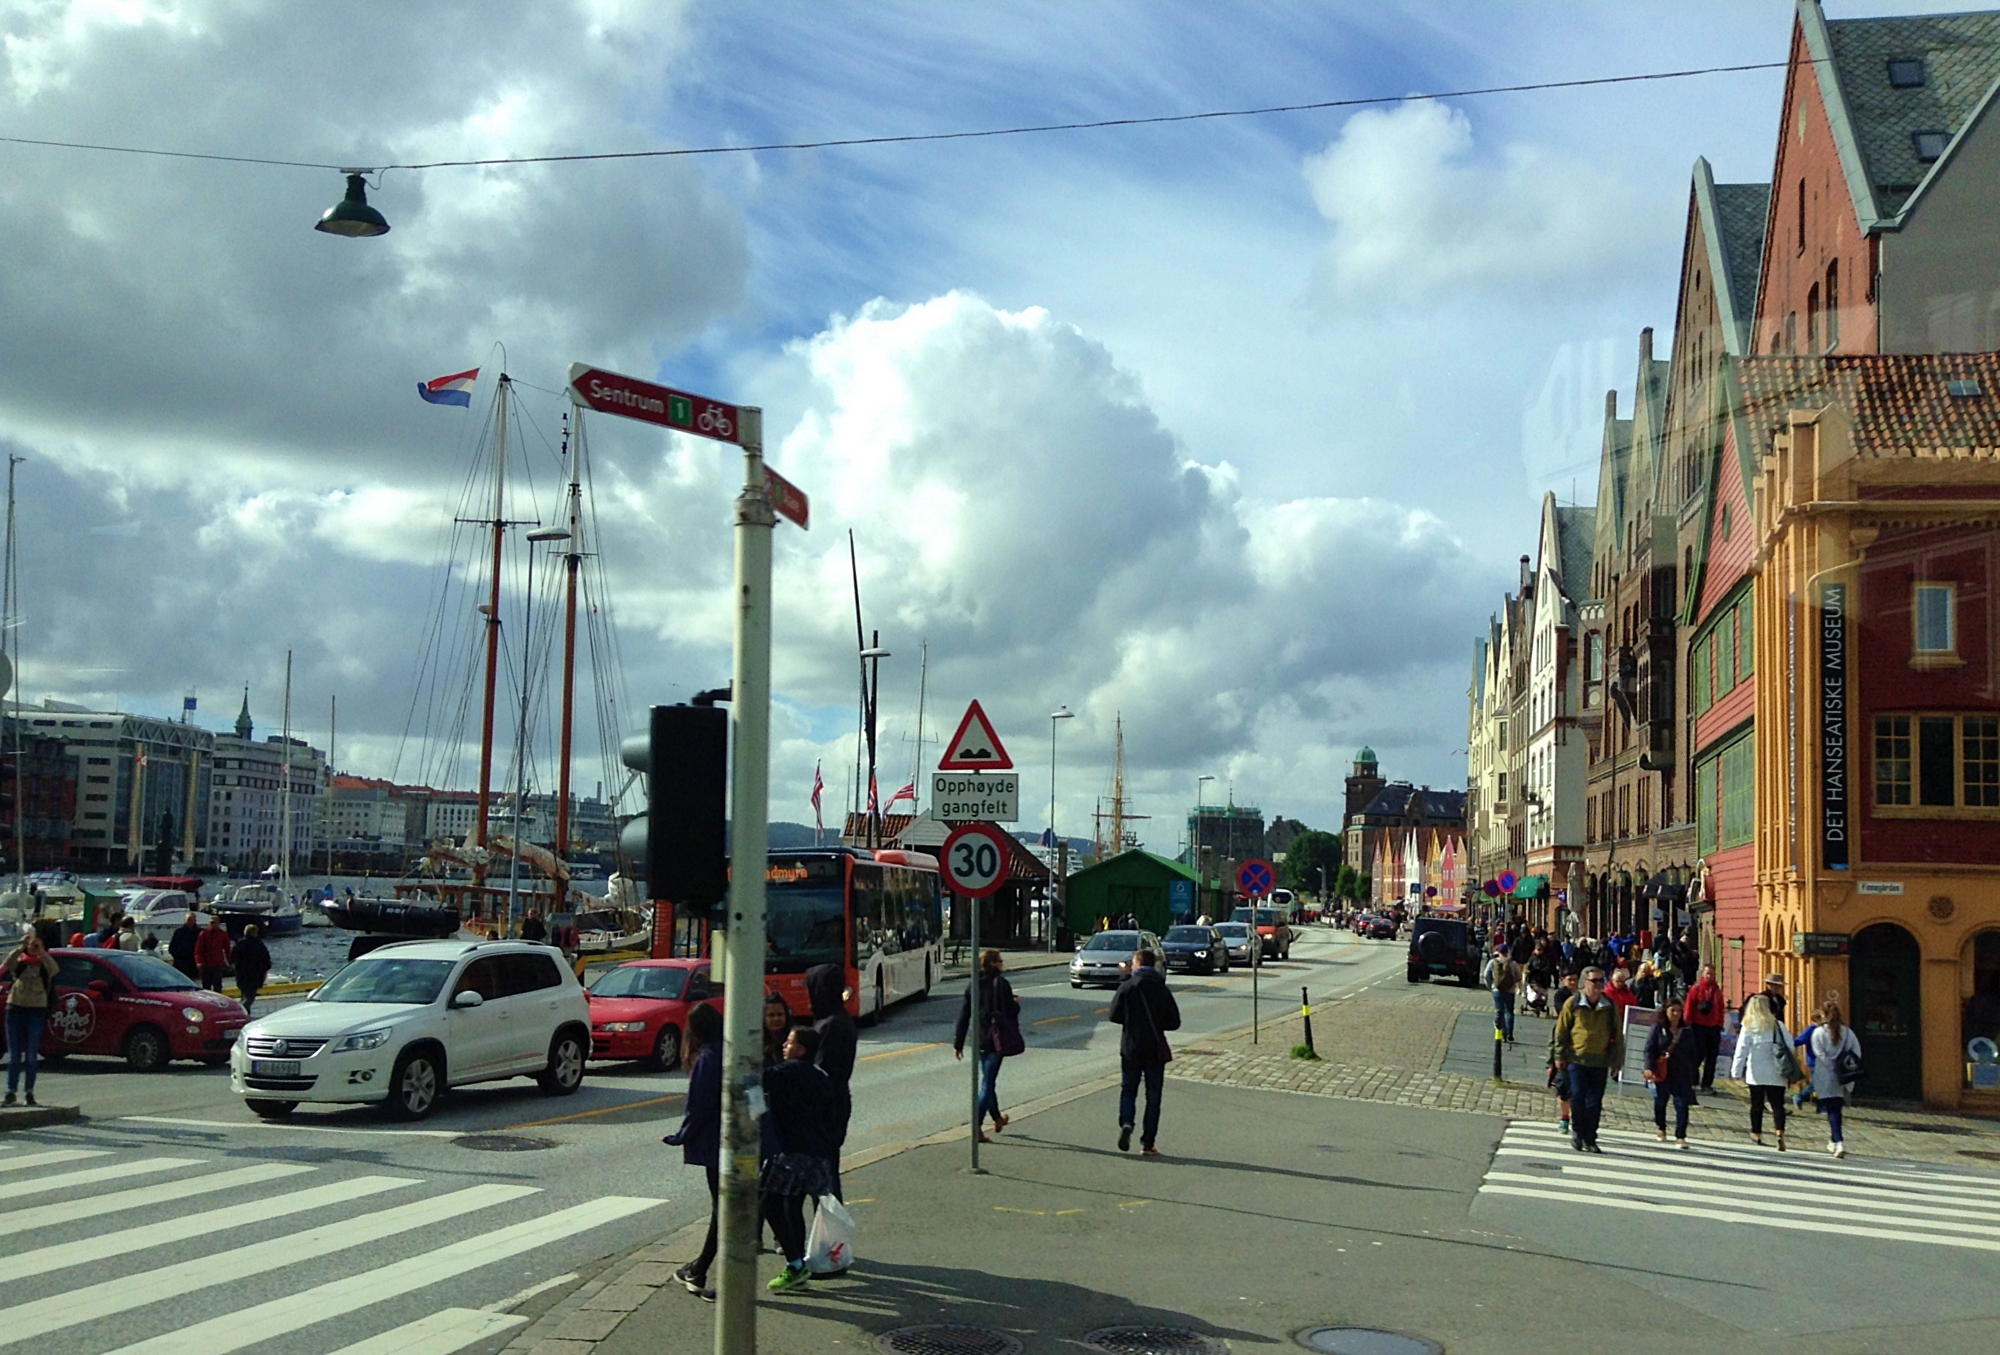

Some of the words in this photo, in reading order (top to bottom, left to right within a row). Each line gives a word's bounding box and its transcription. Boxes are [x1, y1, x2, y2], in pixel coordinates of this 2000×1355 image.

[590, 378, 664, 414] Sentrum
[676, 402, 684, 419] 1
[1824, 588, 1842, 670] MUSEUM
[1825, 677, 1843, 800] HANSEATISKE
[935, 778, 1015, 797] Opphøyde
[942, 799, 1008, 818] gangfelt
[1826, 808, 1844, 841] DET
[953, 842, 997, 878] 30
